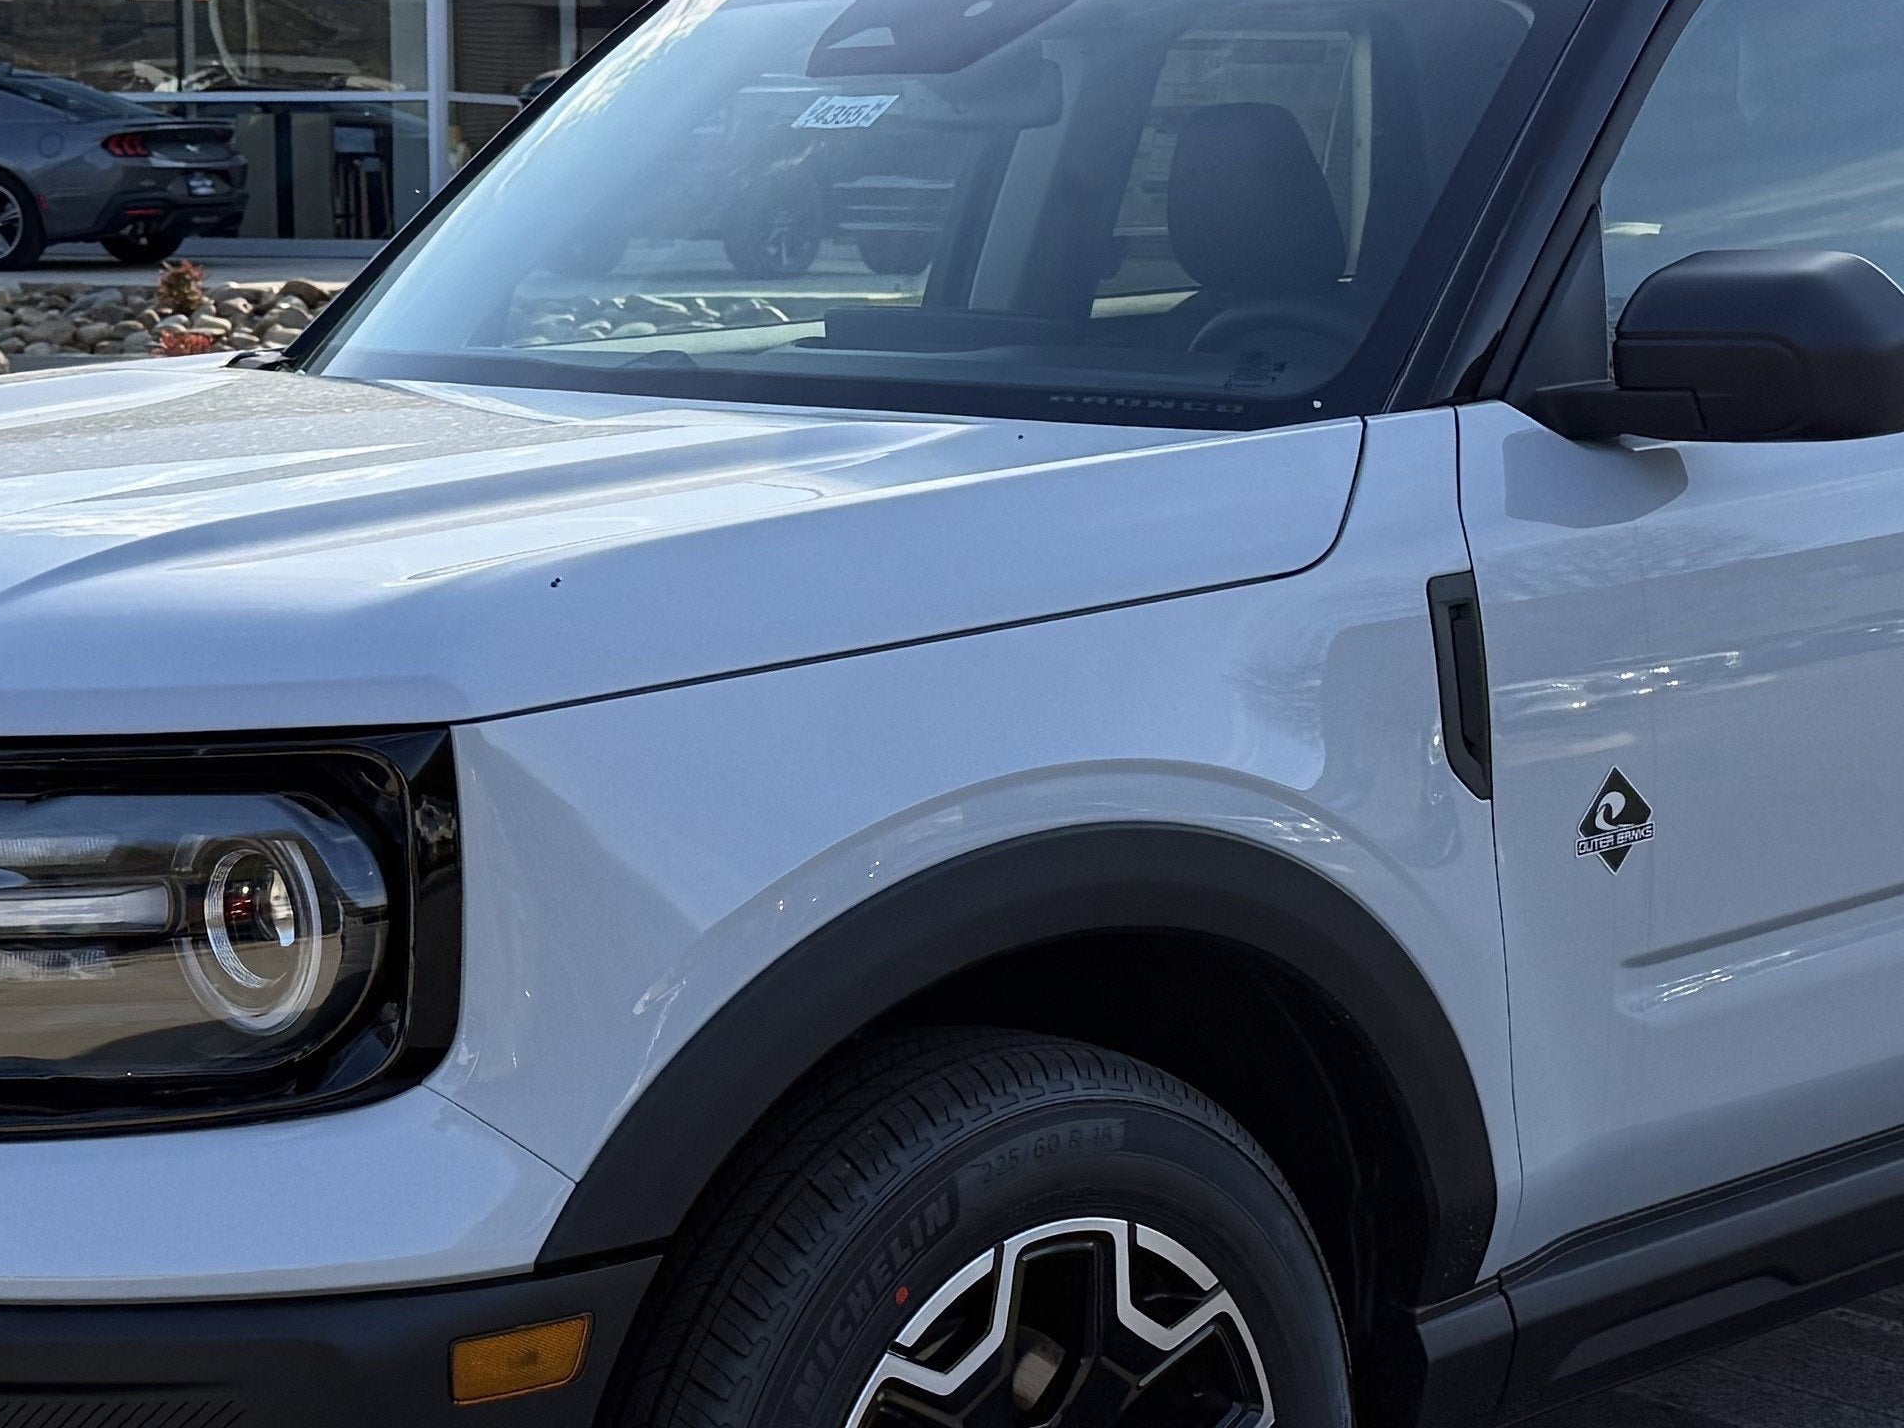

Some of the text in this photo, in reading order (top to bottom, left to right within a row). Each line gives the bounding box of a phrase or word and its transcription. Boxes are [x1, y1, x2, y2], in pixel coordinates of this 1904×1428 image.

[1578, 824, 1653, 855] OUTER BANKS
[792, 1189, 952, 1414] MICHELIN
